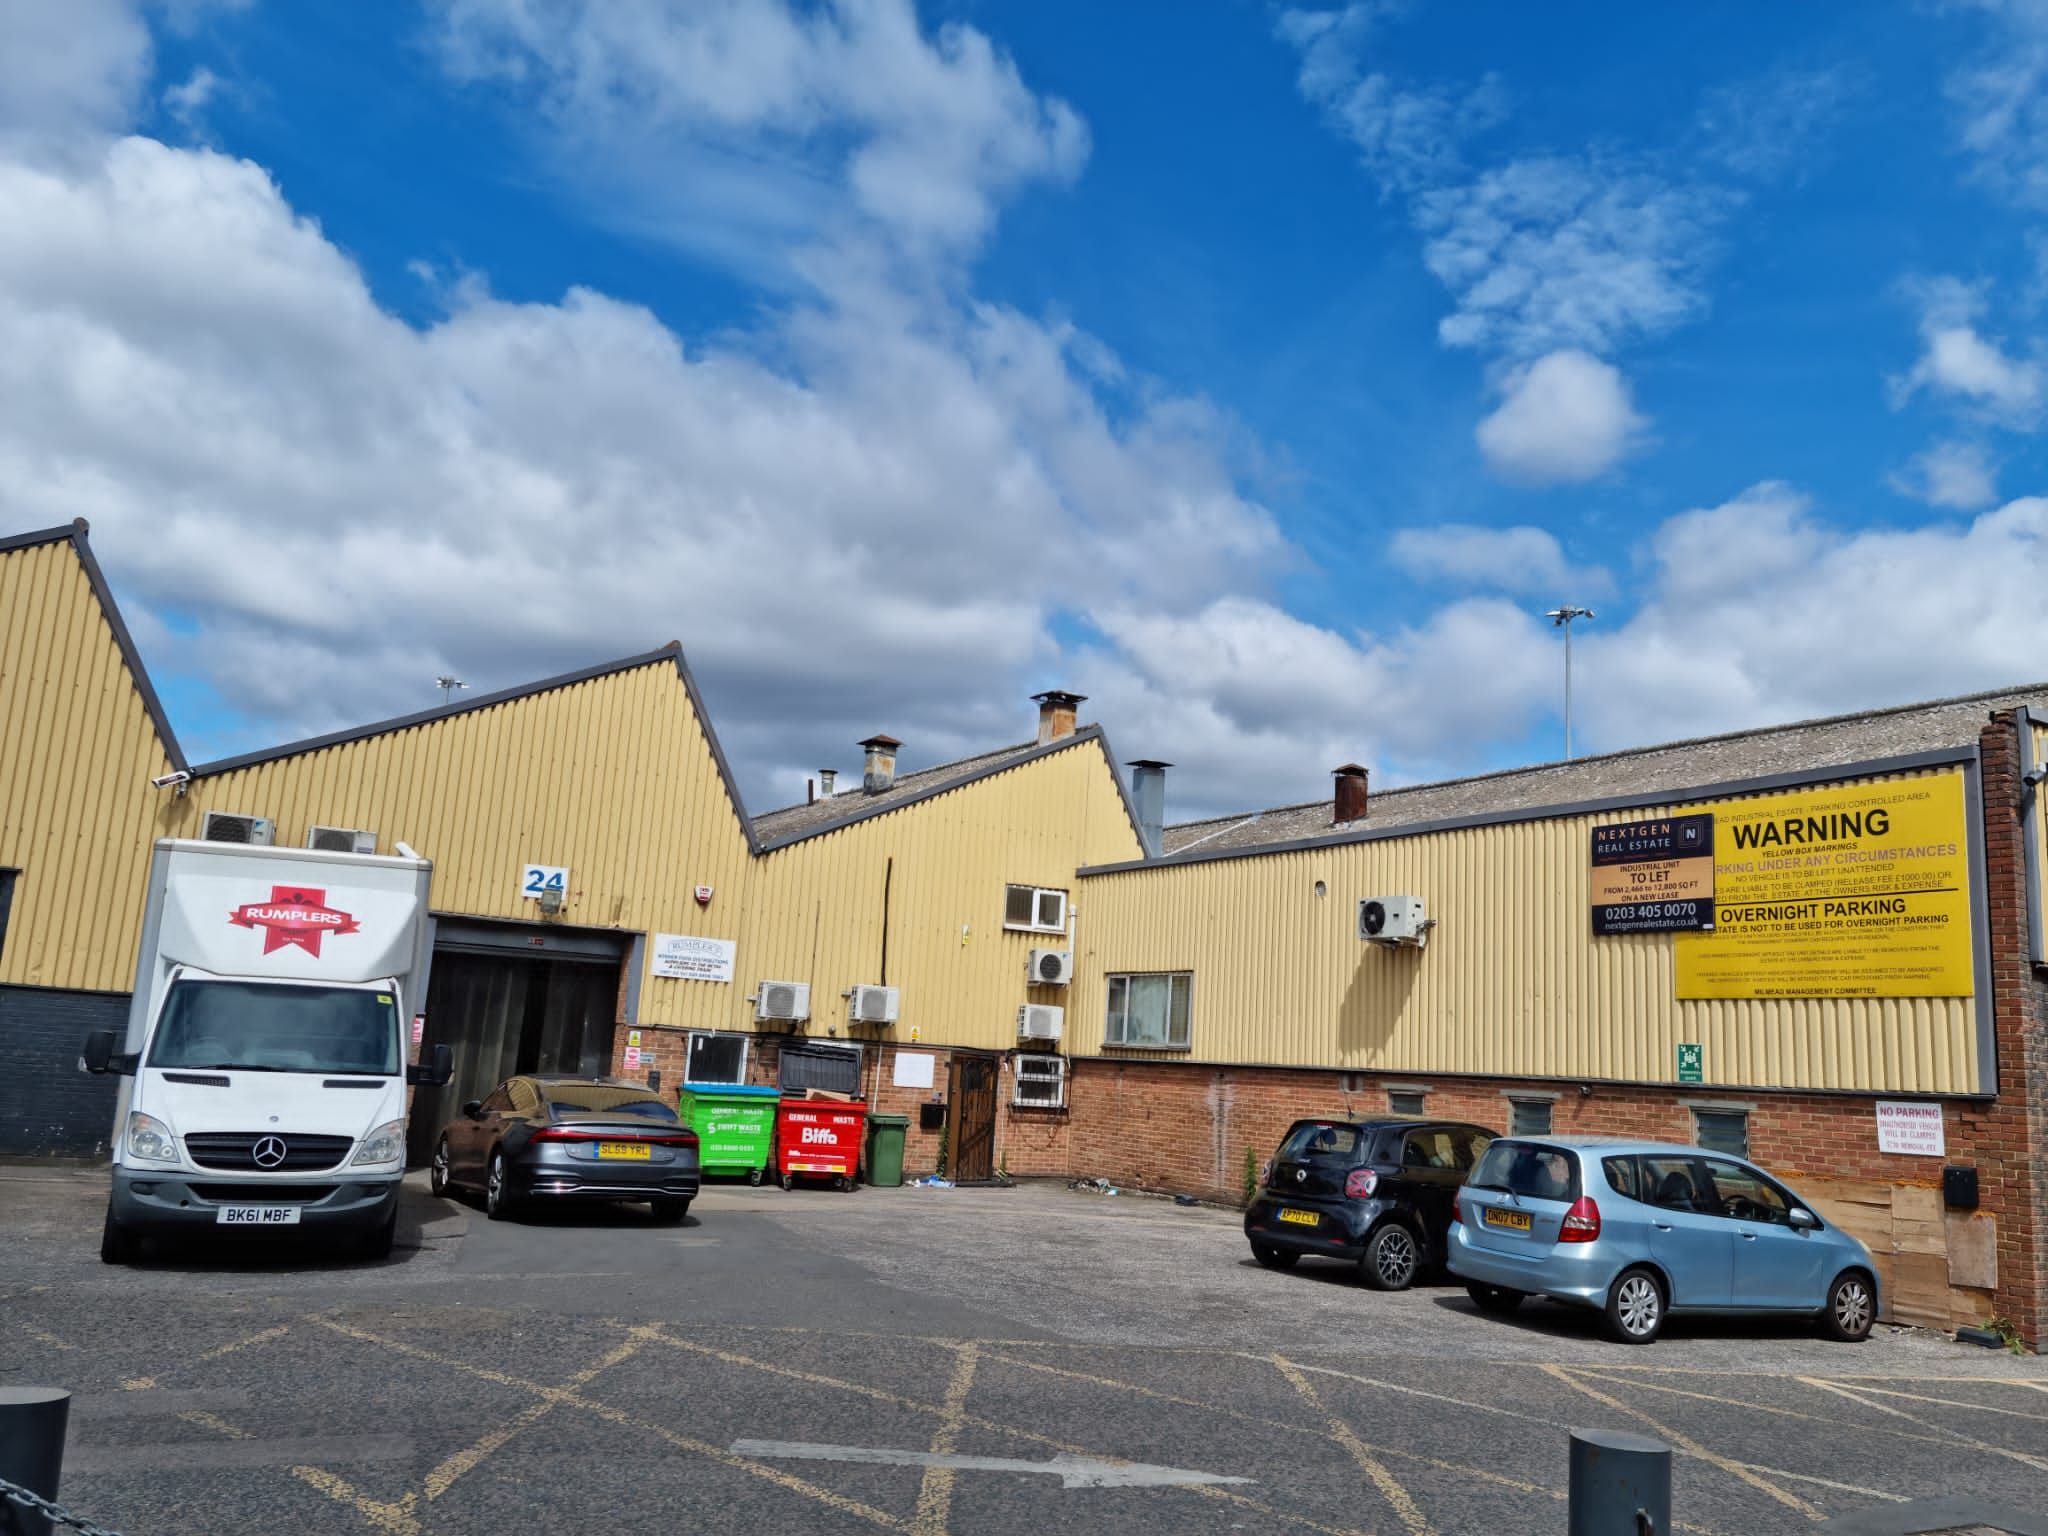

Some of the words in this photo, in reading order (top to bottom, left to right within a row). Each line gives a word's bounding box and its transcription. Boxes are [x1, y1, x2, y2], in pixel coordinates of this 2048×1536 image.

[1731, 813, 1774, 823] INDUSTRIAL
[1776, 808, 1803, 816] ESTATE
[1809, 802, 1846, 811] PARKING
[1848, 795, 1905, 808] CONTROLLED
[1906, 792, 1931, 800] AREA
[1598, 824, 1670, 840] NEXTGEN
[1686, 829, 1696, 839] N
[1733, 809, 1889, 849] WARNING
[1598, 843, 1624, 853] REAL
[1630, 839, 1670, 850] ESTATE
[1762, 848, 1794, 858] YELLOW
[1814, 842, 1858, 852] MARKINGS
[1620, 862, 1662, 873] INDUSTRIAL
[1663, 861, 1680, 870] UNIT
[1716, 862, 1753, 874] RKING
[1758, 858, 1803, 871] UNDER
[1806, 855, 1830, 866] ANY
[1835, 844, 1957, 864] CIRCUMSTANCES
[525, 869, 564, 892] 24
[1631, 873, 1647, 884] TO
[1649, 871, 1670, 882] LET
[1750, 873, 1781, 882] VEHICLE
[1792, 870, 1802, 878] TO
[1804, 869, 1814, 877] BE
[1815, 868, 1835, 876] LEFT
[1837, 864, 1895, 873] UNATTENDED
[1604, 887, 1624, 895] FROM
[1654, 882, 1677, 891] 12,800
[1678, 881, 1689, 889] SQ
[1742, 884, 1768, 892] LIABLE
[1795, 879, 1832, 888] CLAMPED
[1877, 875, 1894, 883] FEE
[1937, 871, 1952, 879] OR
[1622, 894, 1632, 902] ON
[1657, 891, 1680, 899] LEASE
[1728, 893, 1751, 901] FROM
[1753, 892, 1768, 900] THE
[1772, 890, 1801, 899] ESTATE
[1815, 888, 1832, 896] THE
[1833, 885, 1872, 895] OWNERS
[1872, 883, 1892, 892] RISK
[1902, 880, 1944, 889] EXPENSE
[246, 908, 342, 924] RUMPLERS
[1605, 906, 1635, 920] 0203
[1638, 905, 1661, 917] 405
[1664, 902, 1697, 916] 0070
[1721, 904, 1818, 923] OVERNIGHT
[1824, 898, 1906, 917] PARKING
[1605, 917, 1699, 930] nextgenrealestate.co.uk
[1740, 925, 1748, 933] IS
[1750, 924, 1769, 932] NOT
[1771, 923, 1782, 931] TO
[1784, 922, 1795, 931] BE
[1798, 921, 1821, 930] USED
[1825, 920, 1844, 928] FOR
[1846, 917, 1901, 928] OVERNIGHT
[1904, 914, 1949, 924] PARKING
[789, 1113, 817, 1122] GENERAL
[833, 1116, 855, 1125] WASTE
[1880, 1106, 1894, 1116] NO
[1896, 1107, 1939, 1119] PARKING
[801, 1127, 838, 1145] Biffa
[226, 1208, 260, 1222] BK61
[263, 1209, 292, 1222] MBF
